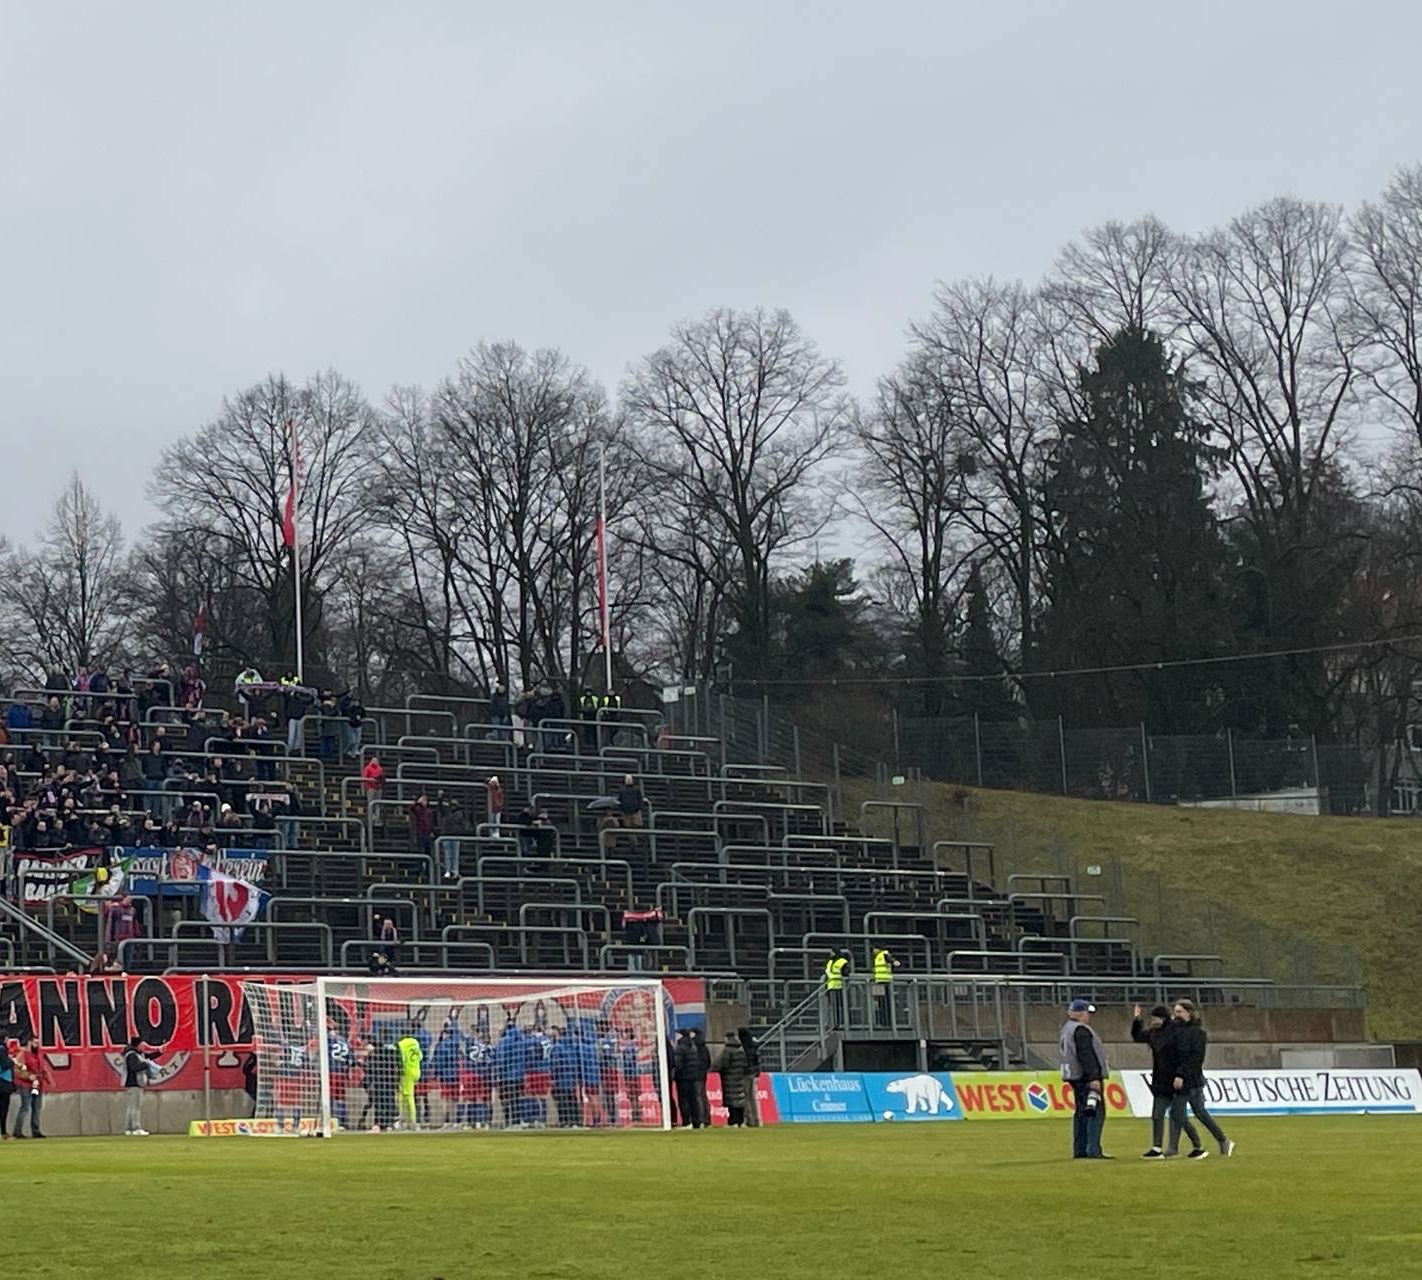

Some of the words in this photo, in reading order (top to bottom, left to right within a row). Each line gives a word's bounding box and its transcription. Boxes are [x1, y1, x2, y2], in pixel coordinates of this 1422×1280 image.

[955, 1084, 1027, 1113] WEST
[1046, 1083, 1129, 1110] LOO
[1317, 1072, 1414, 1101] ZEITUNG
